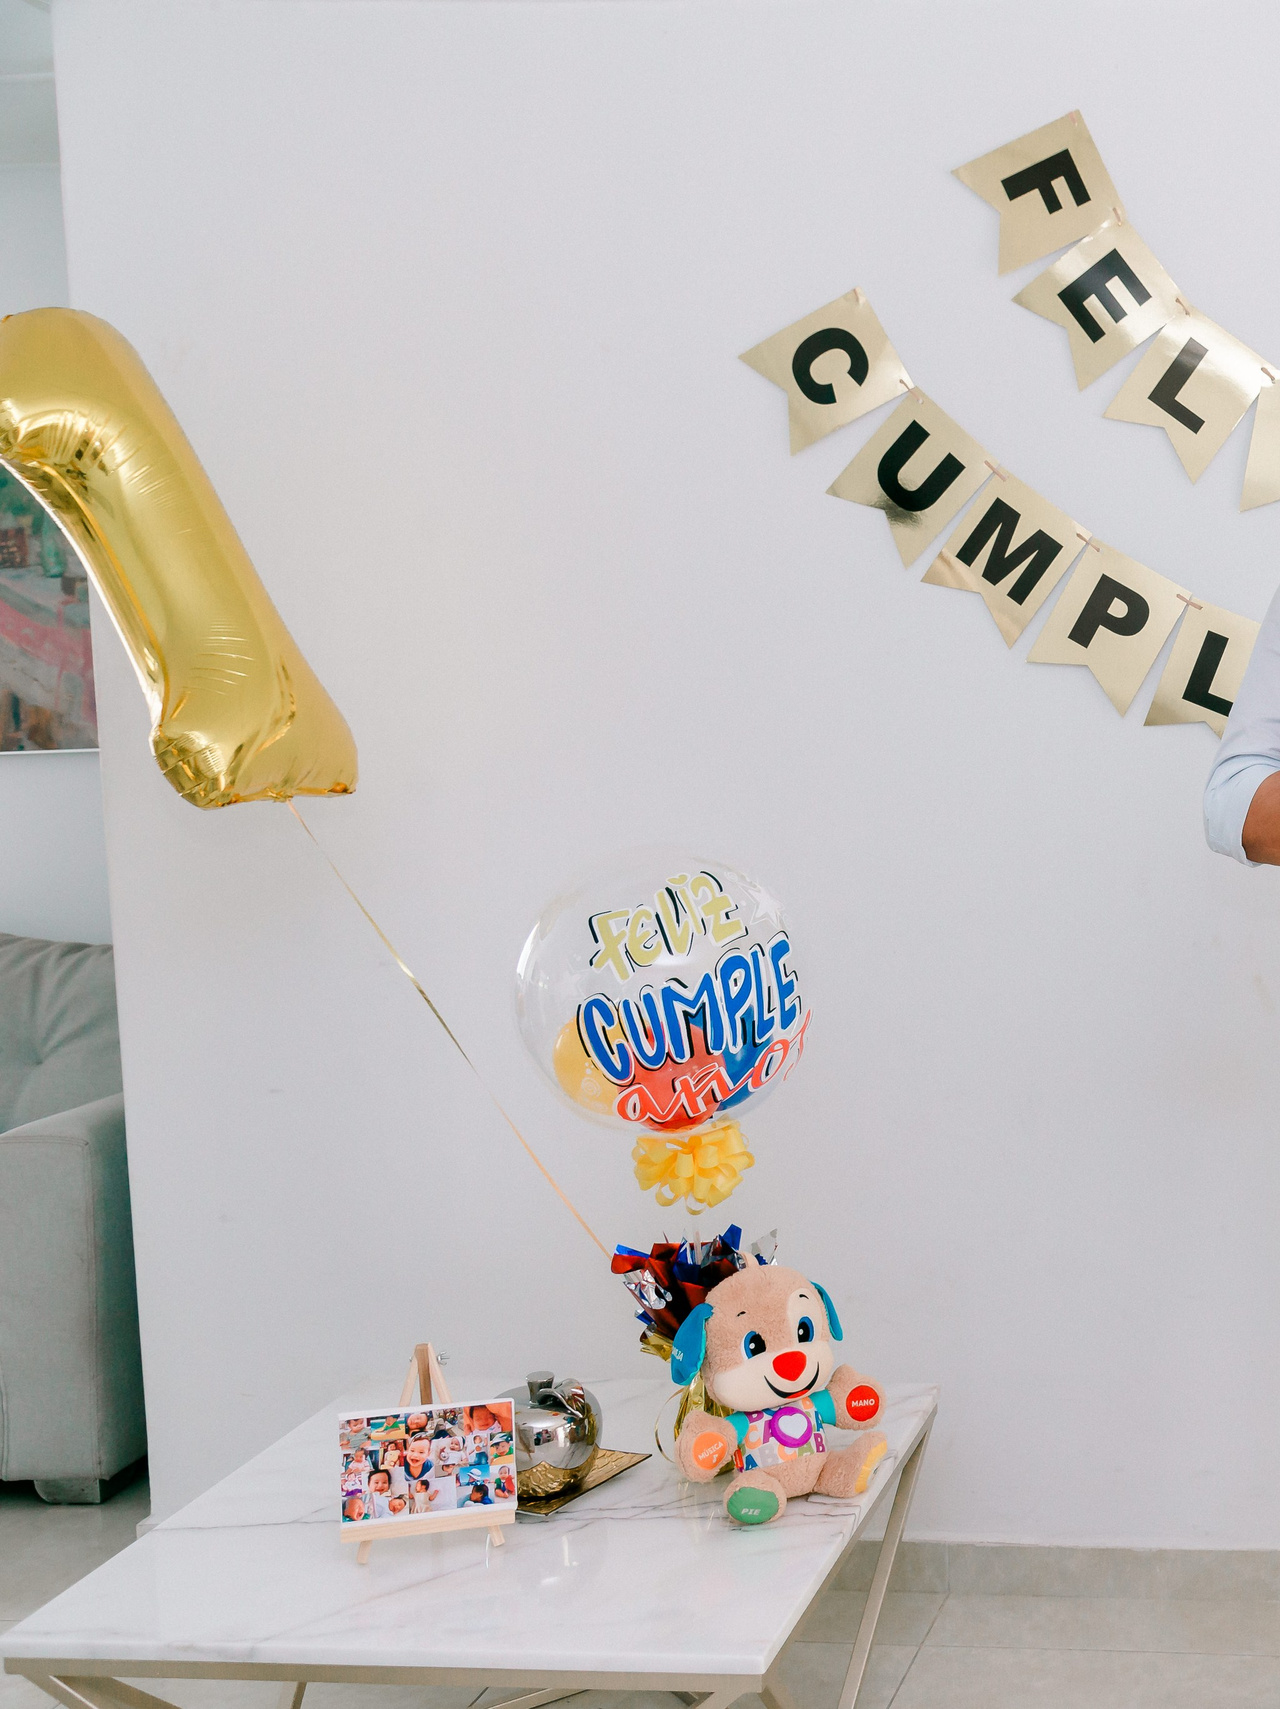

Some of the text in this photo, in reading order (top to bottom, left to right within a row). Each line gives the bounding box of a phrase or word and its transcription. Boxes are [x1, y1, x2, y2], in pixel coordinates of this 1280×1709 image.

[578, 931, 802, 1086] CUMPLE
[851, 1397, 876, 1408] MANO
[697, 1441, 724, 1461] MÚSICA
[741, 1507, 761, 1516] PIE
